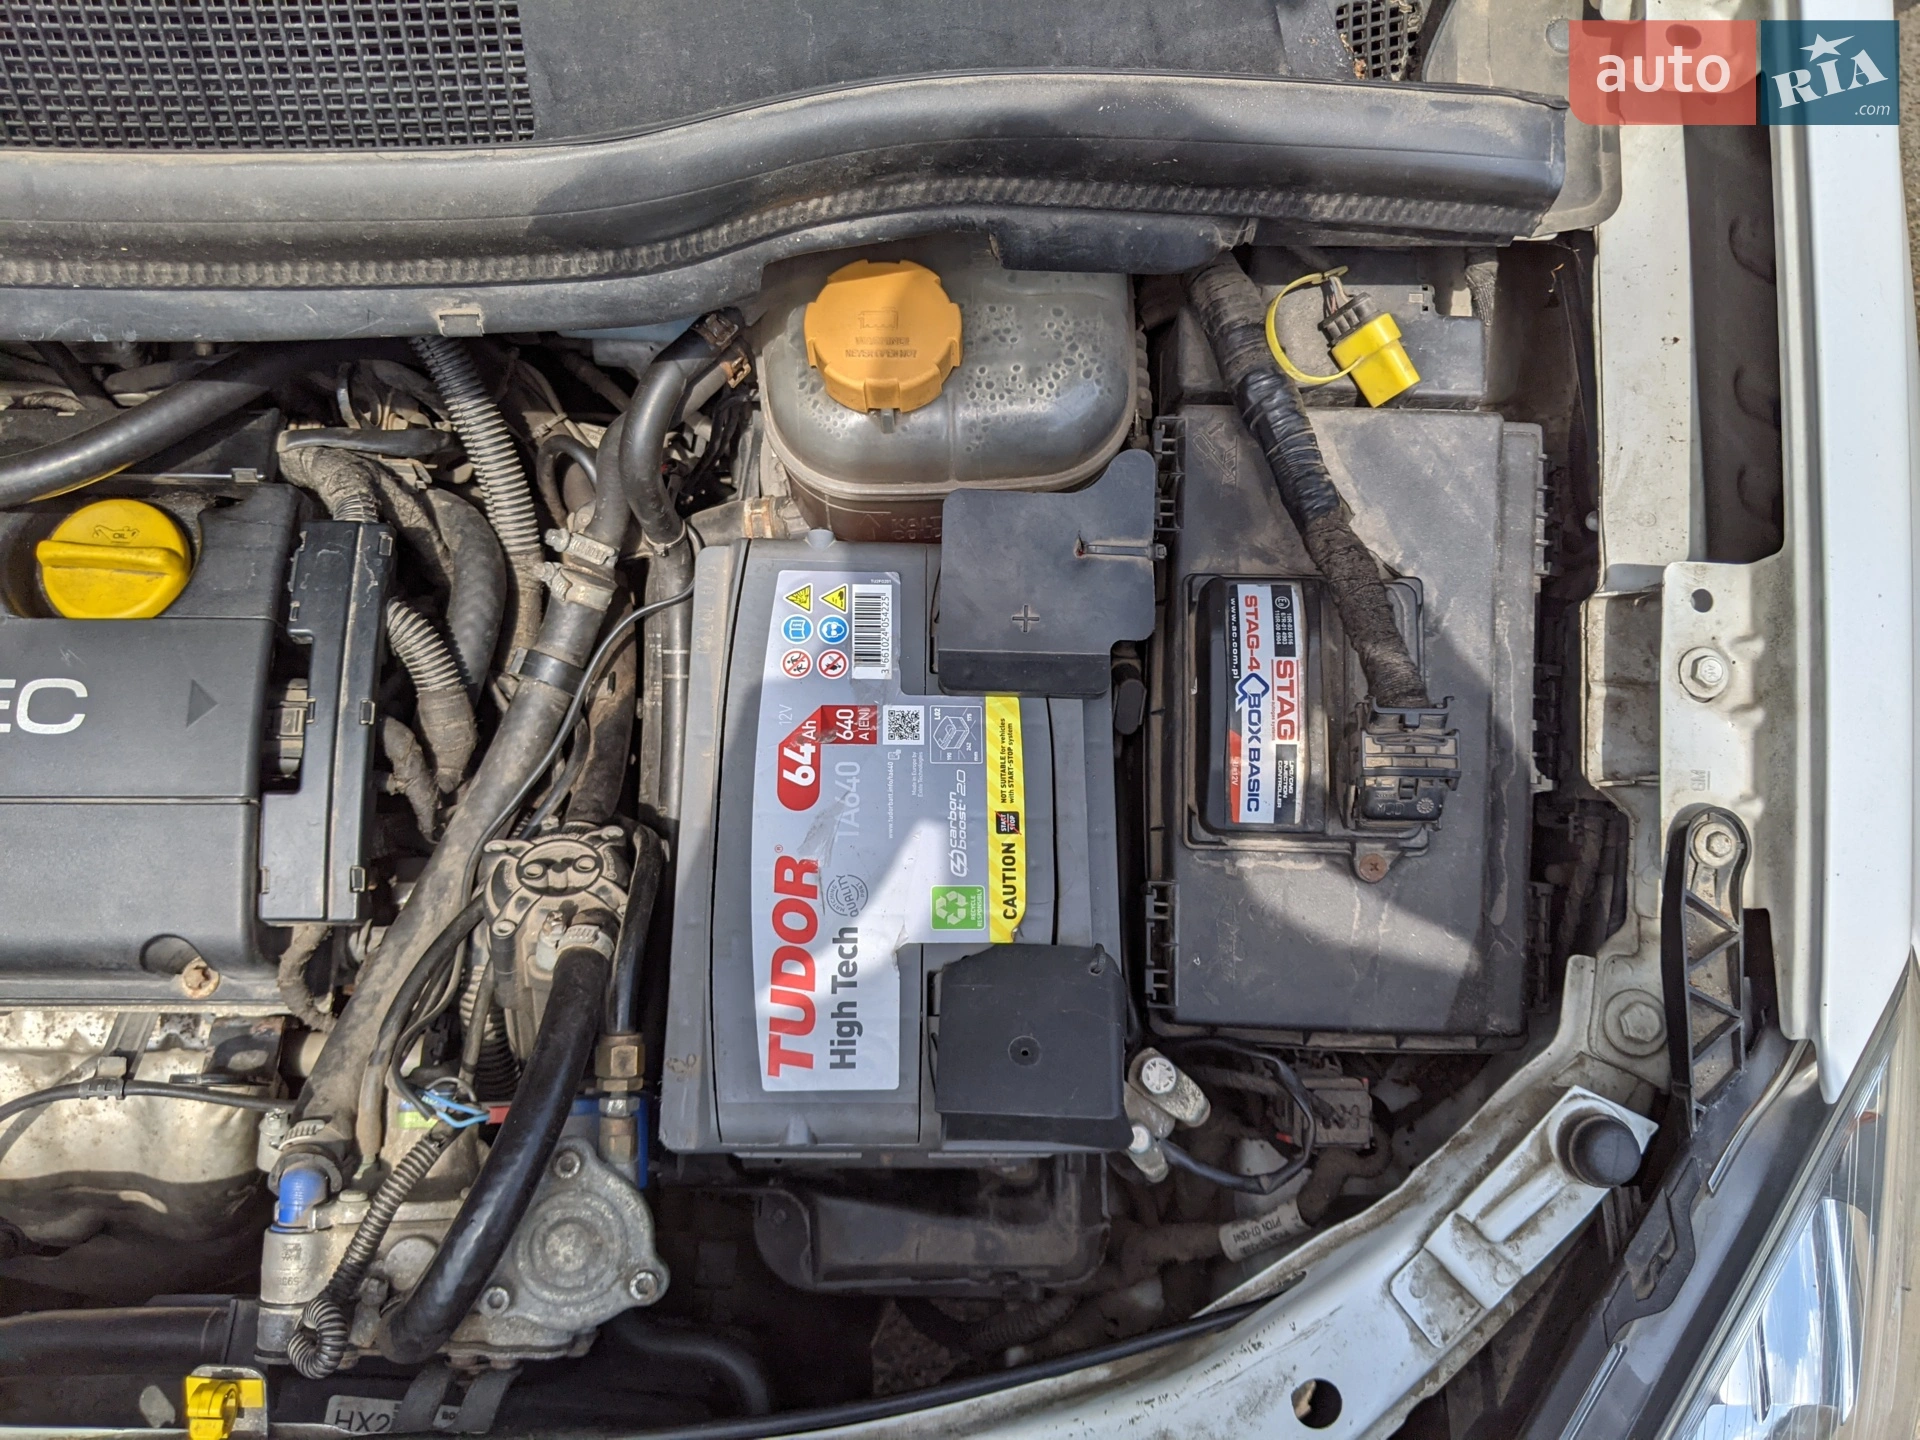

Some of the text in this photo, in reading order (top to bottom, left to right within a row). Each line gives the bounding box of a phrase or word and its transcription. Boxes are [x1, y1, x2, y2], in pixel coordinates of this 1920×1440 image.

[881, 596, 889, 627] 054225
[1231, 598, 1239, 679] www.ac.com.pl
[1245, 595, 1261, 671] STAG-4
[881, 632, 889, 663] 661024
[779, 704, 793, 725] 12V
[836, 709, 855, 740] 640
[1276, 660, 1295, 740] STAG
[783, 720, 817, 786] 64 Ah
[858, 732, 869, 740] A
[834, 761, 860, 841] TA640
[1247, 748, 1260, 812] BASIC
[948, 792, 957, 848] carbon
[836, 875, 859, 917] QUALITY
[855, 882, 865, 897] PART
[1002, 843, 1017, 919] CAUTION
[768, 855, 819, 1077] TUDOR
[830, 927, 863, 1069] High Tech
